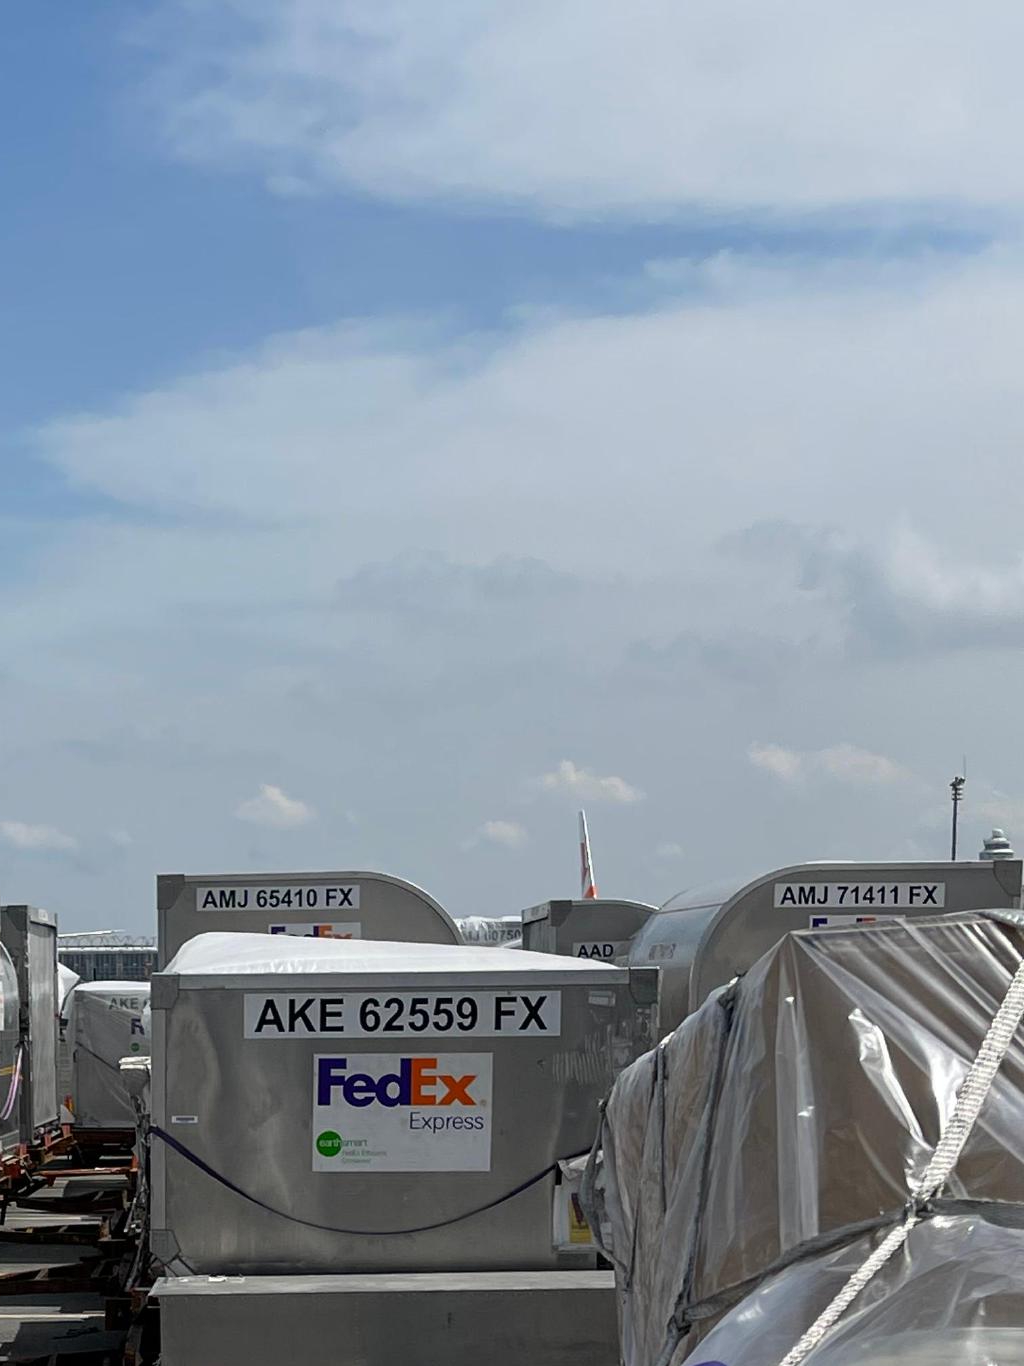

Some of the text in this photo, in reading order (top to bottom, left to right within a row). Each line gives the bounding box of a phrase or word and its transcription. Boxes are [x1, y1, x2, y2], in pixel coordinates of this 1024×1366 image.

[202, 888, 353, 908] AMJ 65410 FX
[780, 886, 937, 905] AMJ 71411 FX
[578, 945, 613, 958] AAD
[108, 998, 138, 1010] AKE
[255, 996, 547, 1032] AKE 62559 FX
[318, 1058, 477, 1107] FedEx
[409, 1112, 484, 1133] Express
